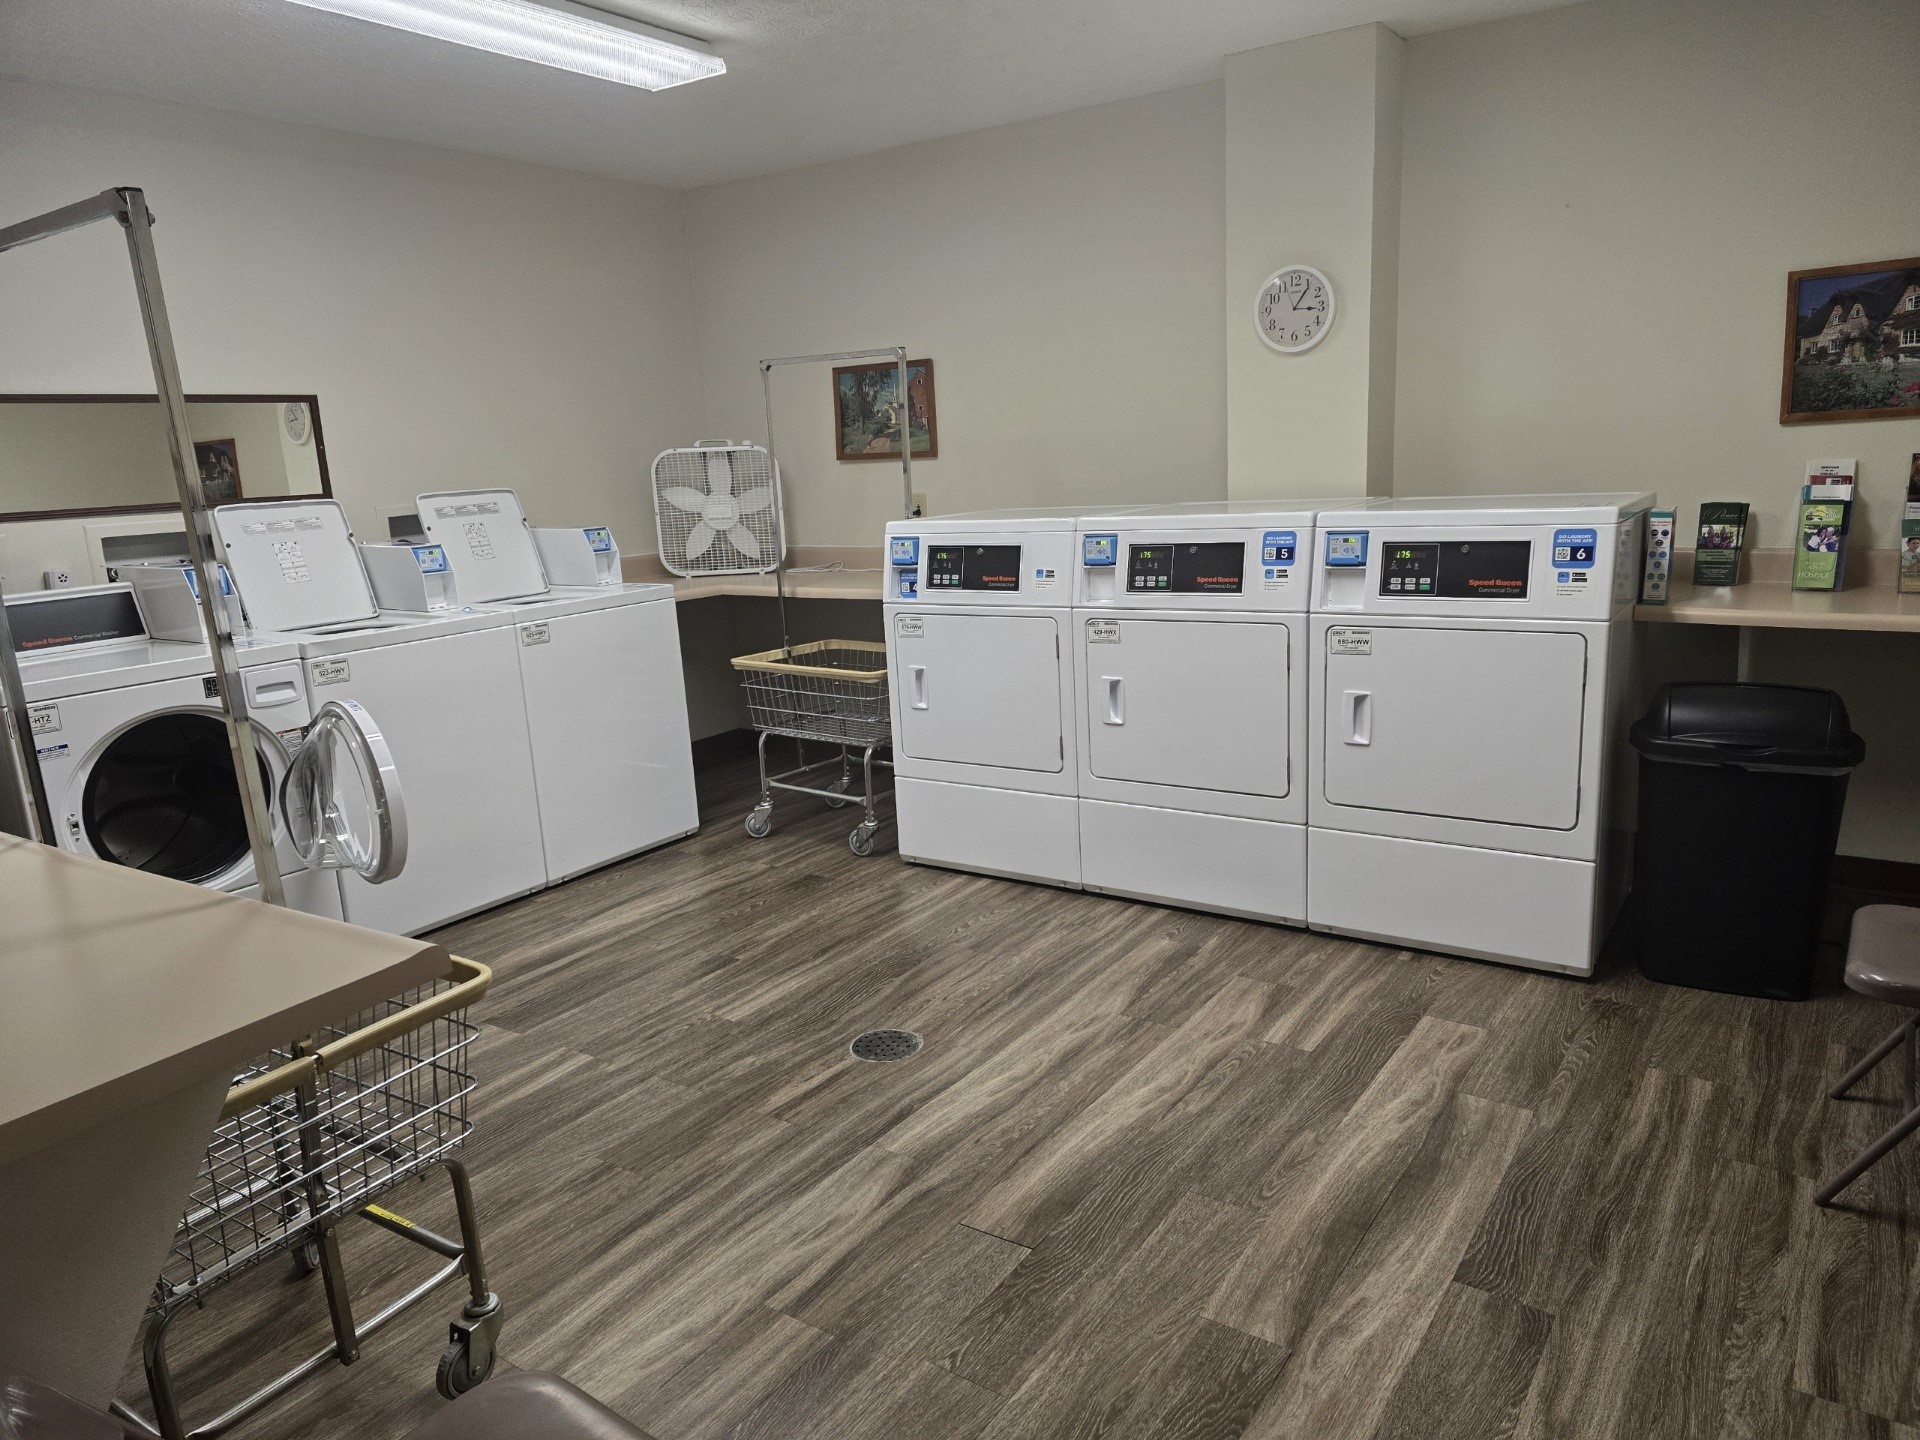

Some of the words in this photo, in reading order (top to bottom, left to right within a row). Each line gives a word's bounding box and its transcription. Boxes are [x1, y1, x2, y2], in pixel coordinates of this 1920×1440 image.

[1290, 275, 1302, 287] 12
[1278, 282, 1287, 293] 11
[1269, 293, 1280, 304] 10
[1281, 548, 1288, 558] 5
[1576, 548, 1586, 560] 6
[22, 639, 47, 647] Speed
[48, 636, 73, 644] Queen
